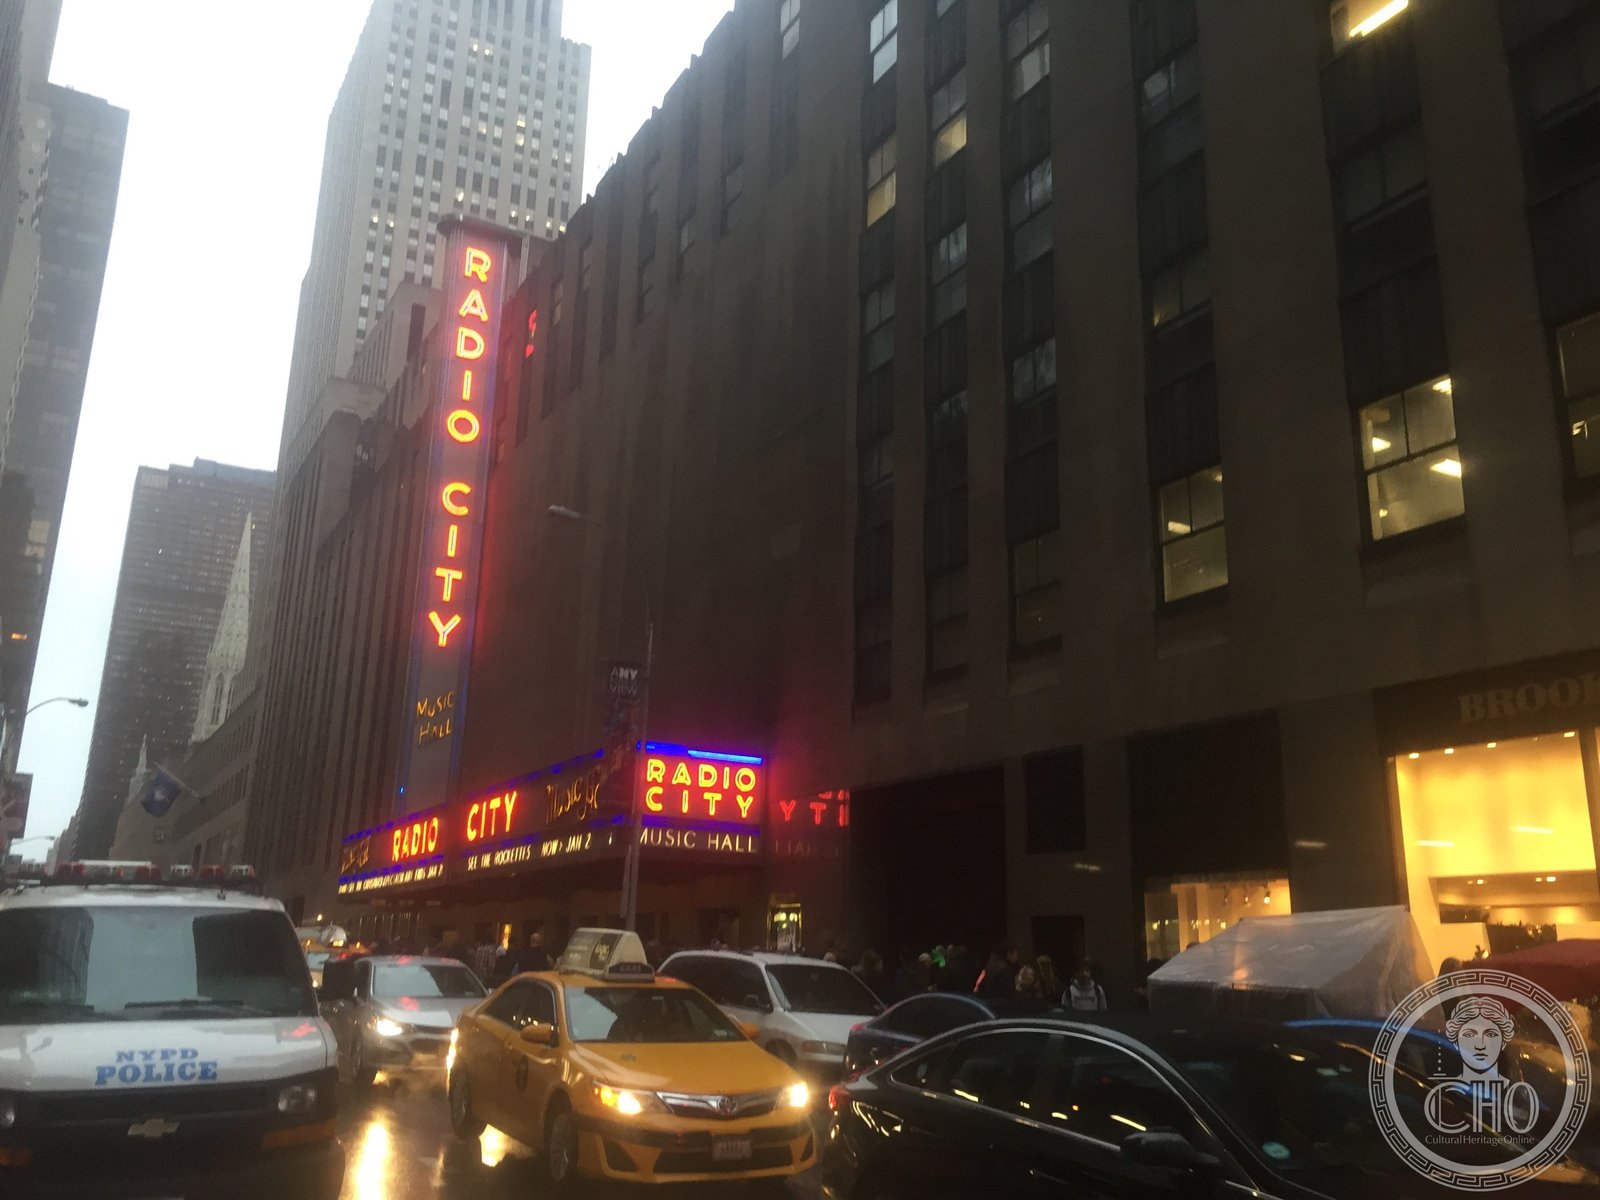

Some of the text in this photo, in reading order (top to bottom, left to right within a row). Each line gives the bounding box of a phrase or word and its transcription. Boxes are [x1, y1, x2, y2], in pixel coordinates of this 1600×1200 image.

[429, 247, 492, 647] RADIO CITY
[416, 690, 455, 718] MUSIC
[418, 718, 451, 744] HALL
[646, 759, 756, 792] RADIO
[645, 786, 754, 818] CITY
[392, 817, 439, 862] RADIO
[466, 791, 518, 841] CITY
[708, 833, 756, 853] HALL
[468, 854, 478, 871] SEE
[494, 844, 531, 866] ROCKETTES
[116, 1049, 198, 1062] NYPD
[95, 1062, 217, 1085] POLICE
